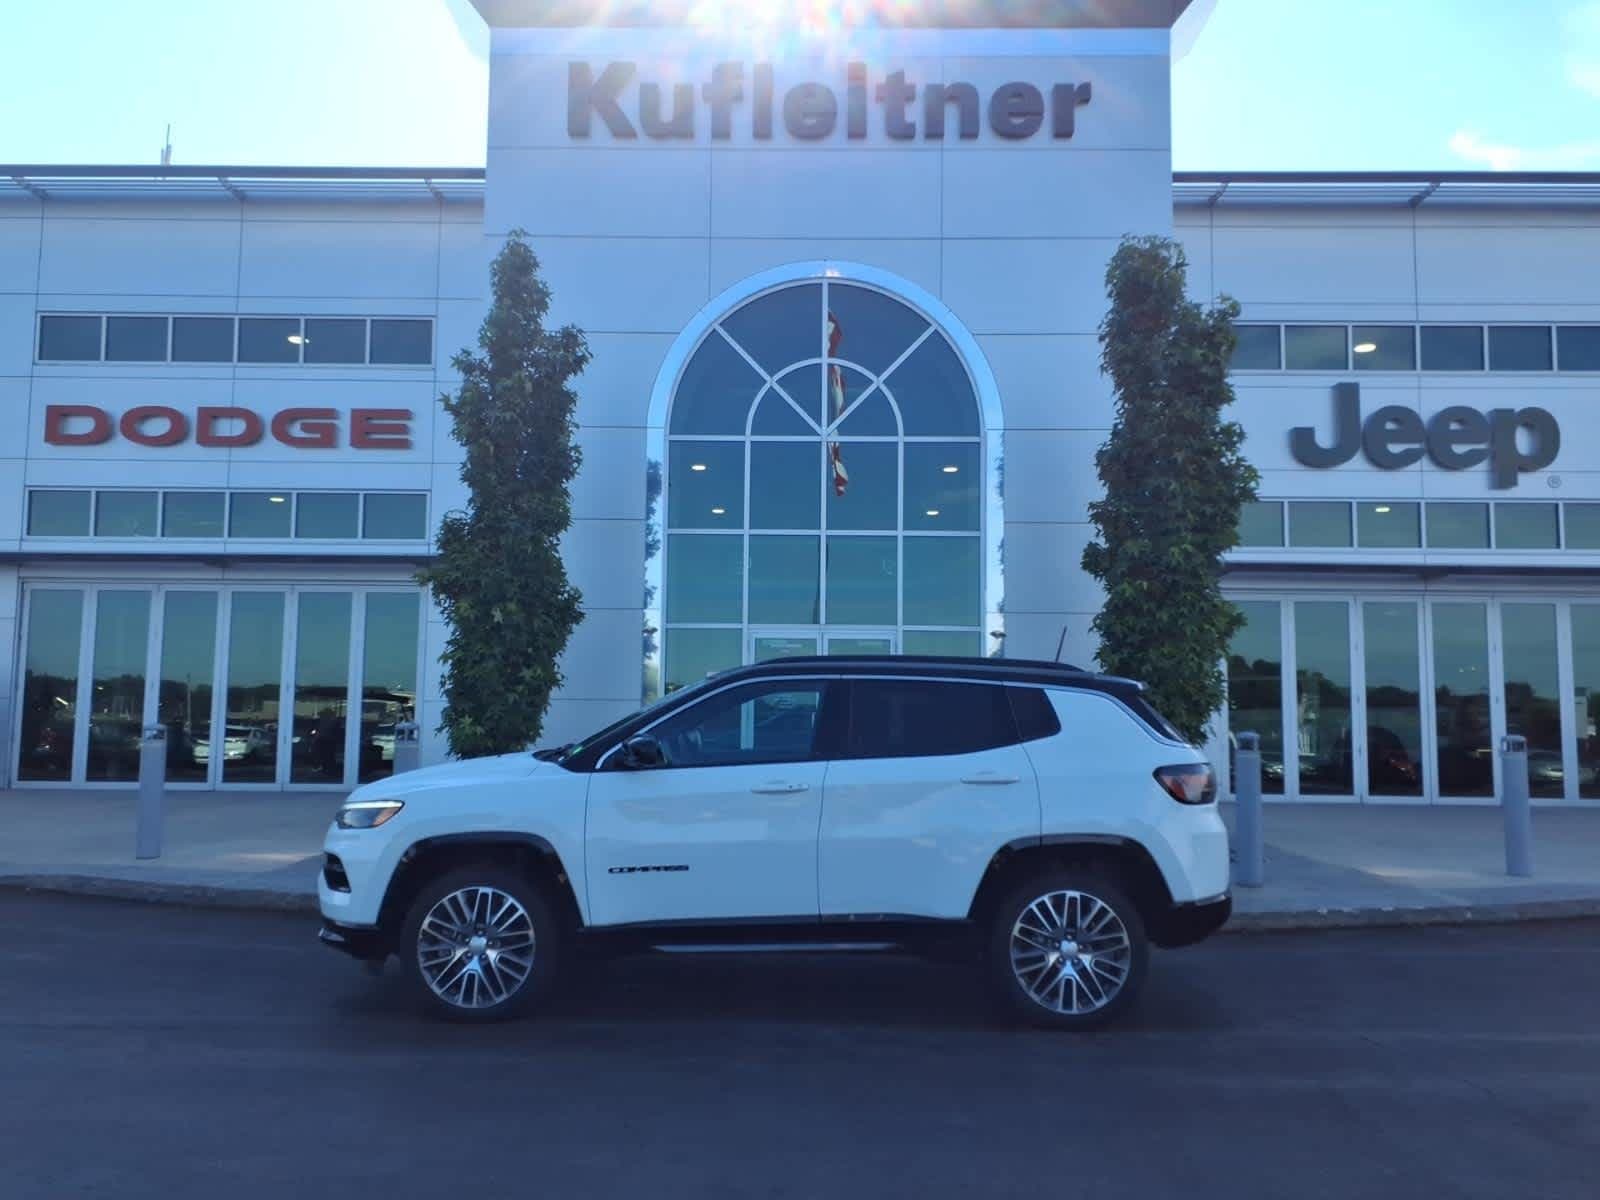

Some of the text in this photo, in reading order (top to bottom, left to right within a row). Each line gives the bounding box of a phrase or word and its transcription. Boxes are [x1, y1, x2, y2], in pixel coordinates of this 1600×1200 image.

[567, 62, 1092, 141] Kufleitner
[44, 405, 414, 449] DODGE
[1289, 382, 1560, 490] Jeep
[608, 865, 690, 874] COMPASS
